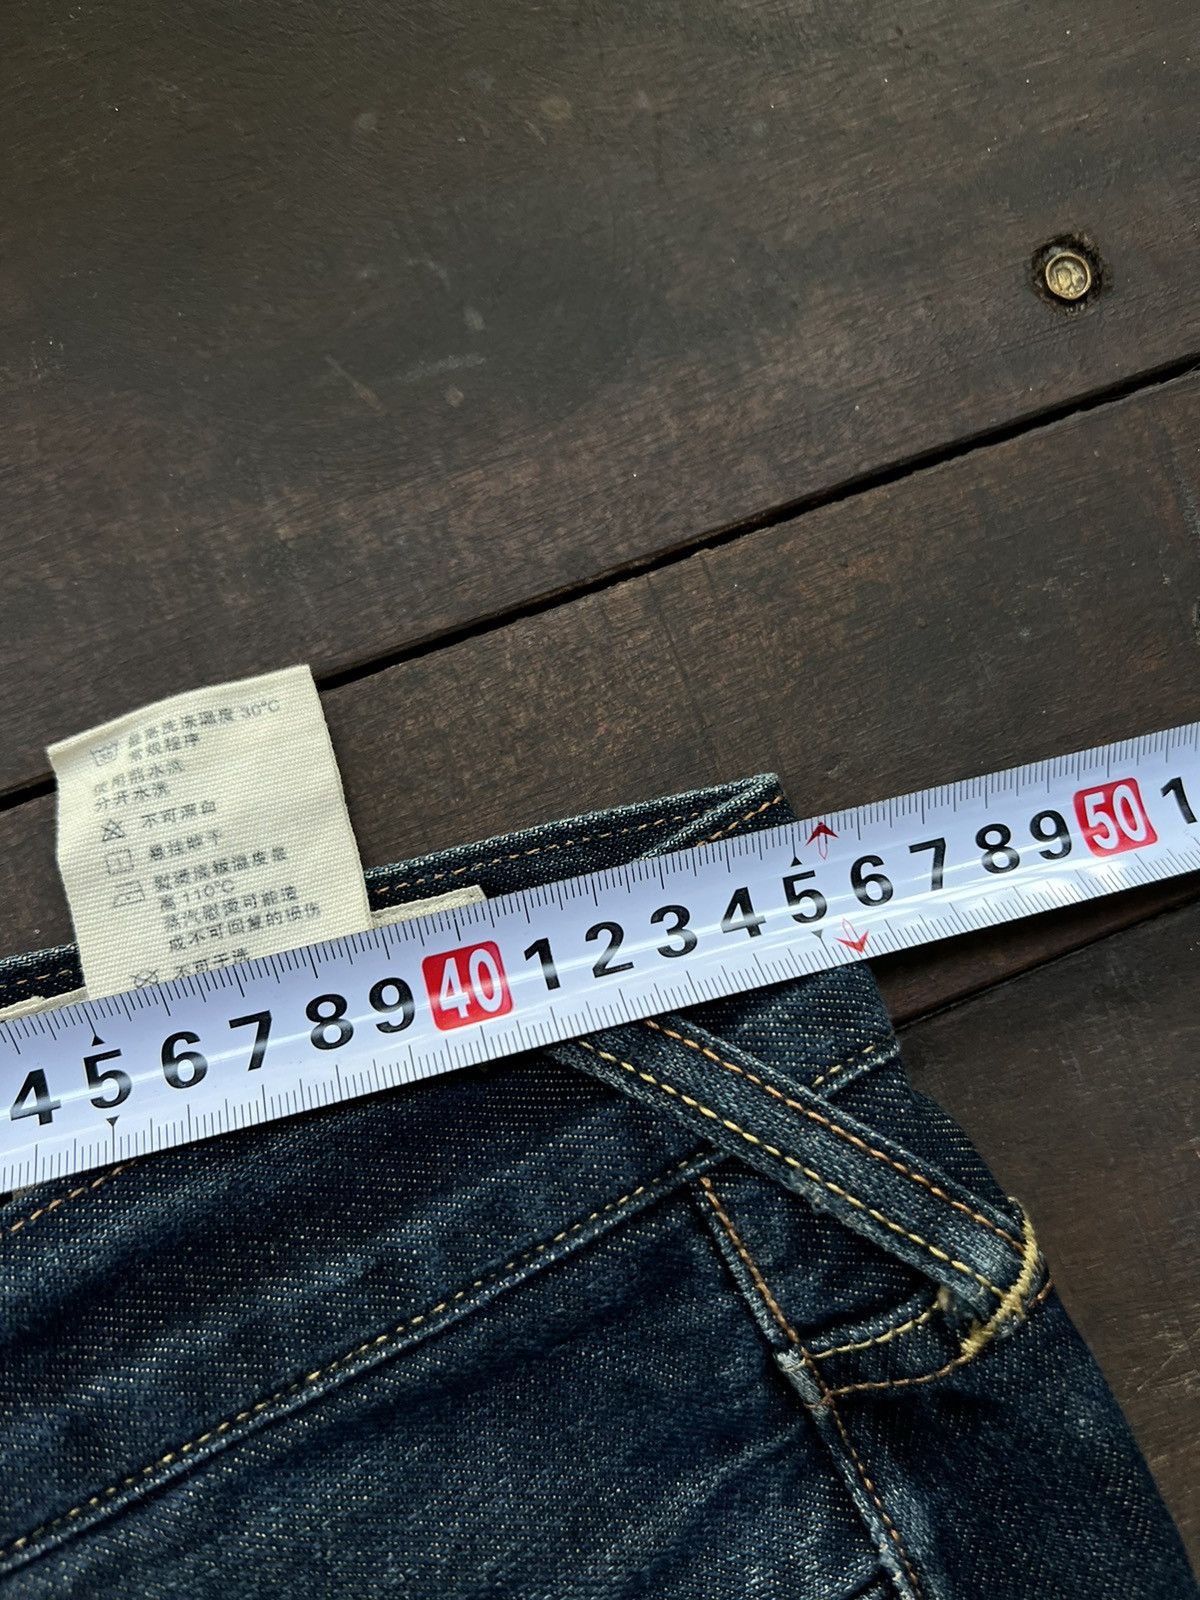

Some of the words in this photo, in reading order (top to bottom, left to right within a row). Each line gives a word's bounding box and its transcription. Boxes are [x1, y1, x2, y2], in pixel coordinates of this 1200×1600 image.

[141, 801, 216, 828] 不可漂白
[160, 895, 176, 912] 高
[10, 1068, 62, 1126] 4
[83, 1048, 133, 1109] 5
[160, 1031, 209, 1089] 6
[228, 1010, 273, 1071] 7
[305, 993, 354, 1051] 8
[368, 976, 416, 1034] 9
[434, 950, 503, 1019] 40
[523, 937, 561, 991] 1
[585, 921, 634, 978] 2
[650, 904, 698, 958] 3
[720, 886, 766, 938] 4
[782, 869, 828, 924] 5
[850, 854, 894, 907] 6
[908, 837, 947, 891] 7
[975, 823, 1020, 874] 8
[1029, 809, 1072, 860] 9
[1083, 783, 1148, 850] 50
[1160, 776, 1197, 825] 1
